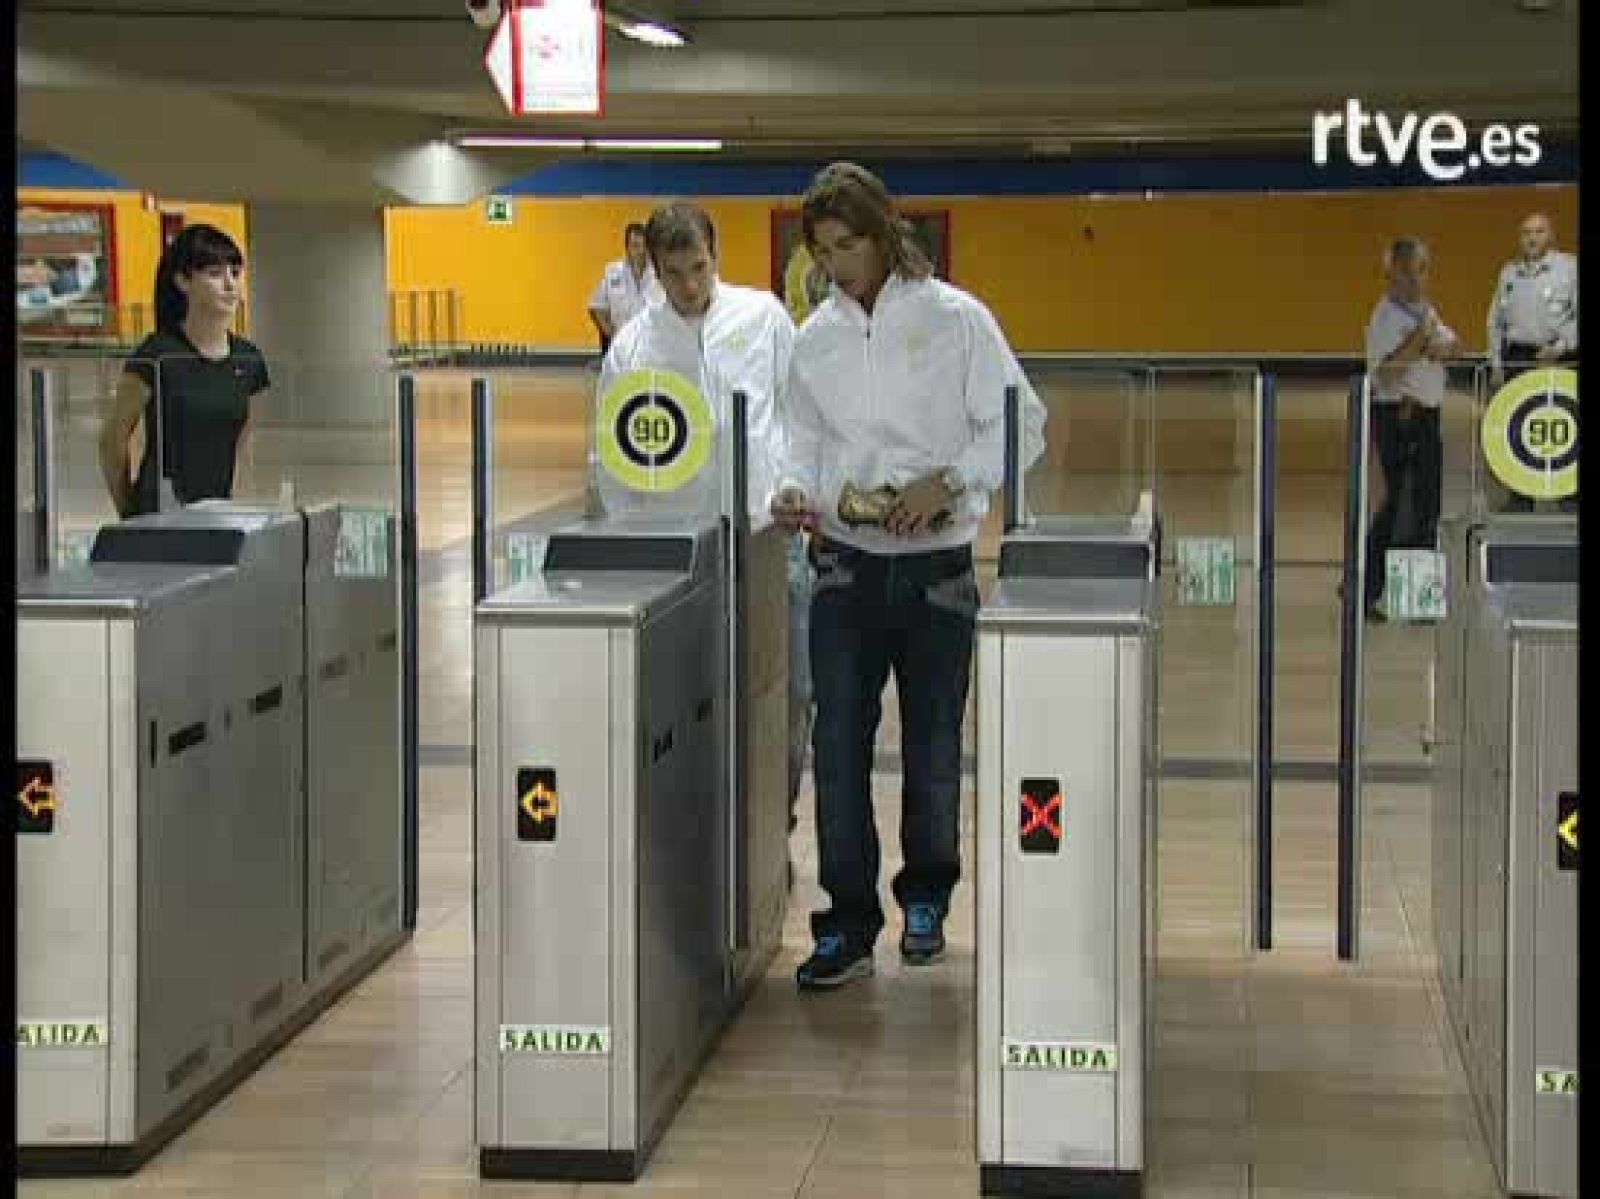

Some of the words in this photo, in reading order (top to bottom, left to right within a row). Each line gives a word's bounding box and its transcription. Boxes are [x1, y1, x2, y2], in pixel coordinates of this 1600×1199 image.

[633, 416, 670, 443] 90
[1529, 418, 1569, 446] 90
[504, 1029, 603, 1052] SALIDA
[1007, 1044, 1107, 1068] SALIDA
